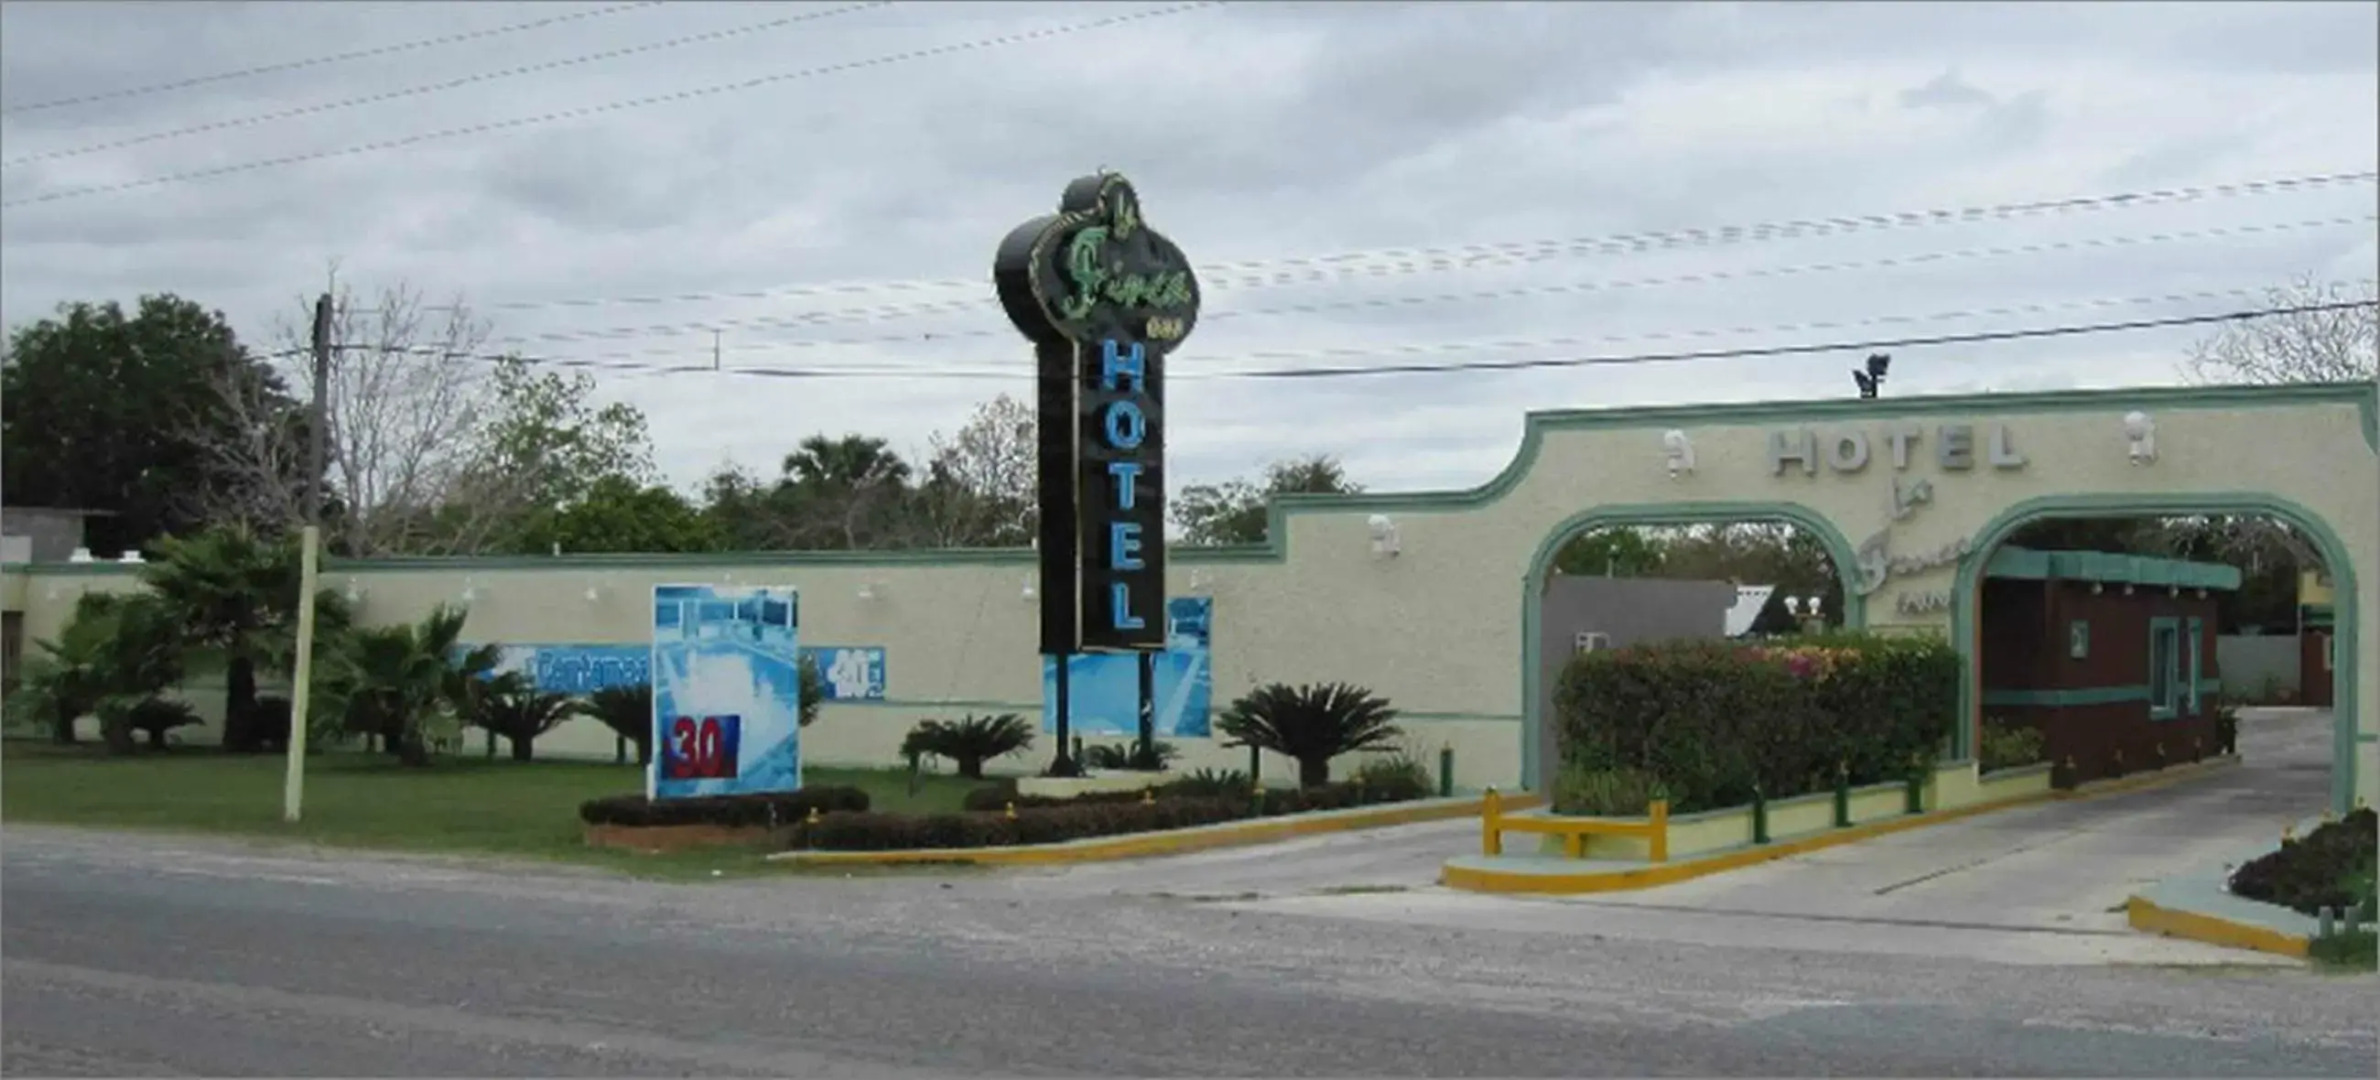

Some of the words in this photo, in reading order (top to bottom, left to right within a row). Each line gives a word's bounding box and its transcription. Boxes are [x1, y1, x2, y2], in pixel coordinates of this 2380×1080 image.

[1768, 424, 2028, 476] HOTEL
[1103, 338, 1147, 629] HOTEL
[672, 715, 723, 779] 30
